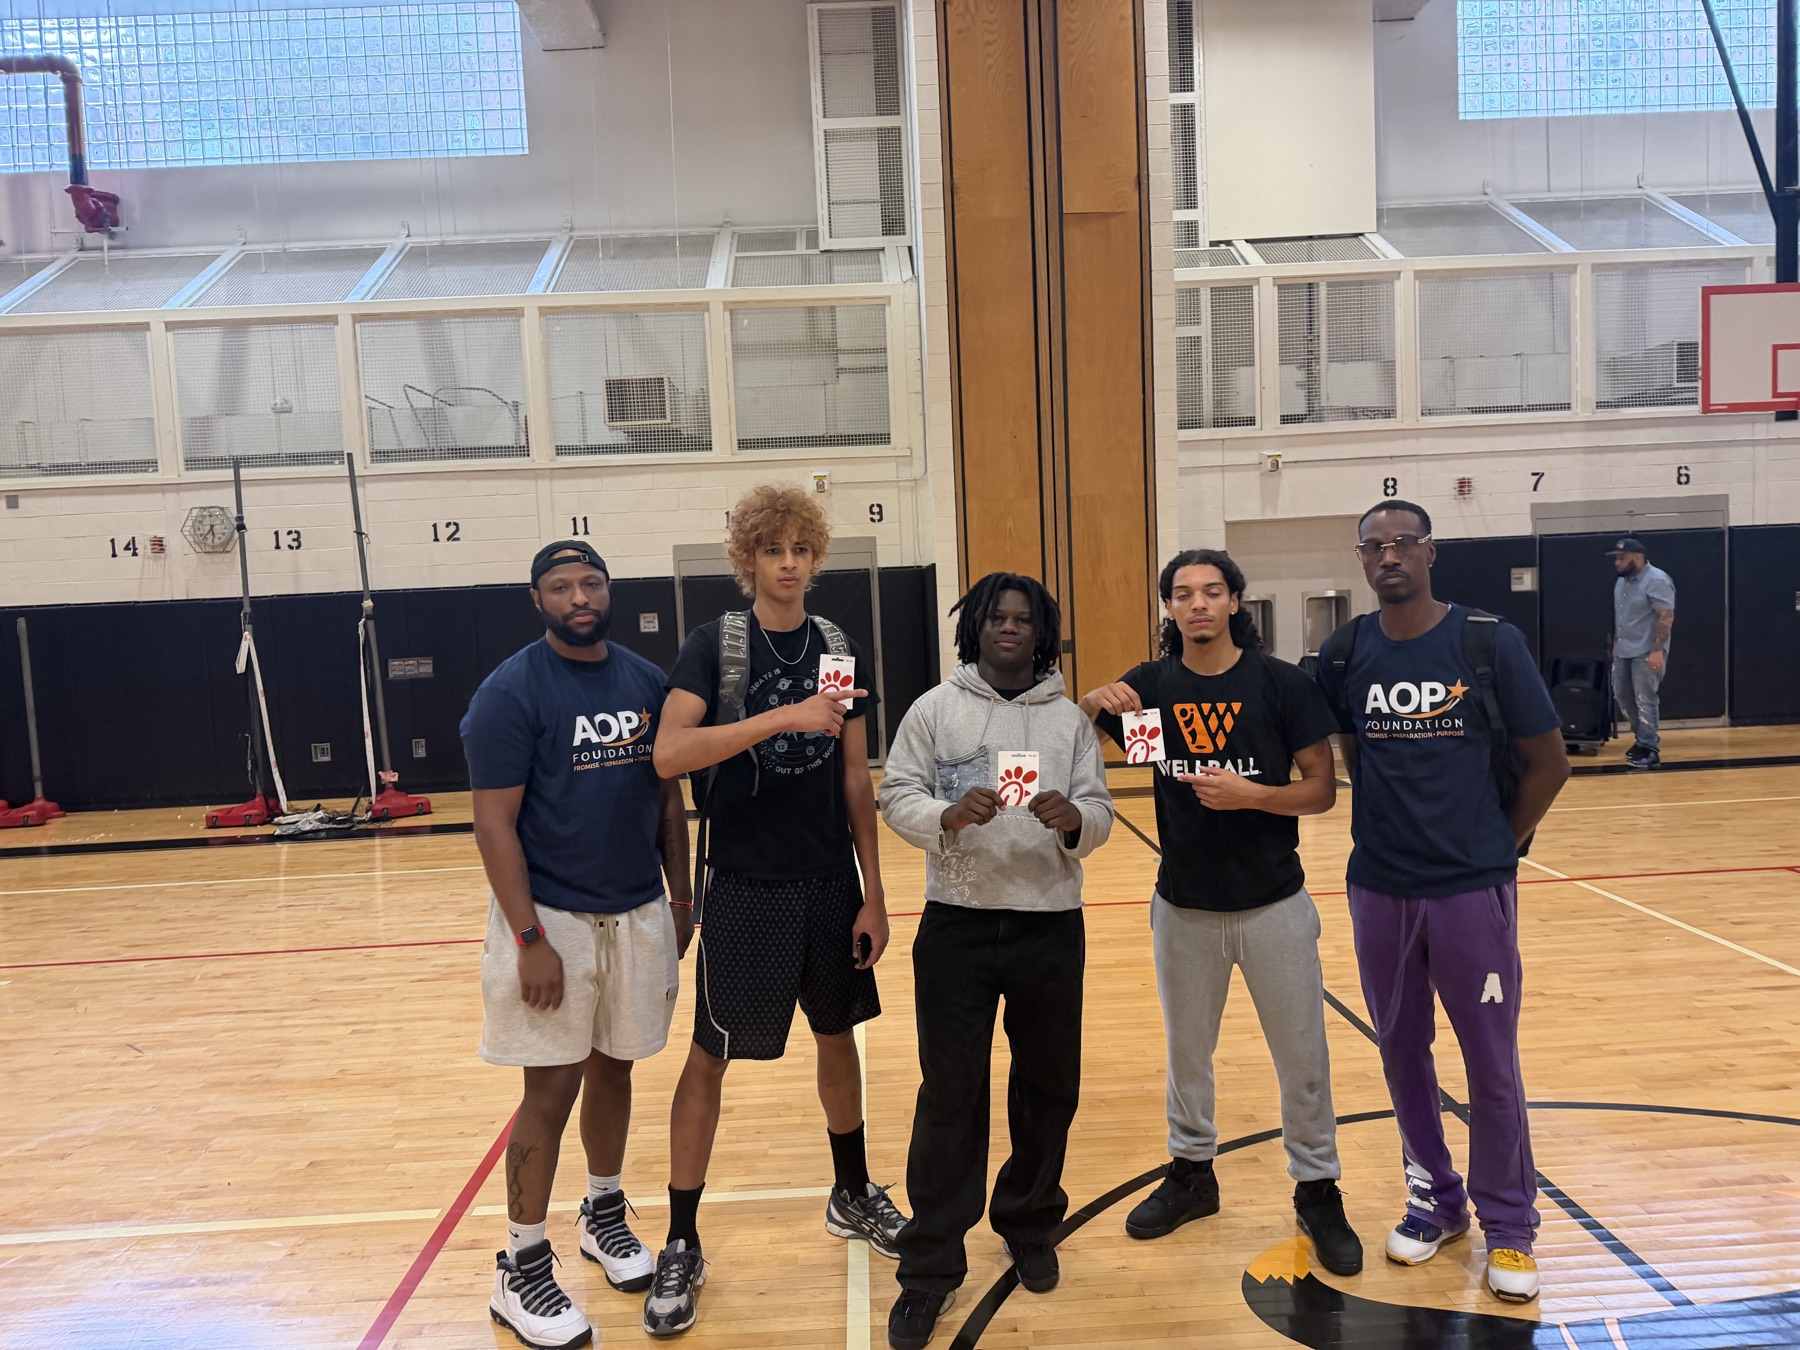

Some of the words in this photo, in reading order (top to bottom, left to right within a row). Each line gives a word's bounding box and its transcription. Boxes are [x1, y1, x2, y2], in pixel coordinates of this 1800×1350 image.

[1530, 471, 1545, 492] 7
[1676, 465, 1691, 486] 6
[1383, 477, 1398, 497] 8
[868, 503, 884, 523] 9
[431, 521, 461, 543] 12
[571, 516, 590, 536] 11
[109, 536, 139, 558] 14
[273, 529, 302, 551] 13
[1364, 681, 1446, 714] AOP
[572, 710, 640, 747] AOP
[1365, 718, 1463, 731] FOUNDATION
[572, 744, 653, 763] FOUDATON
[1480, 972, 1504, 1004] A
